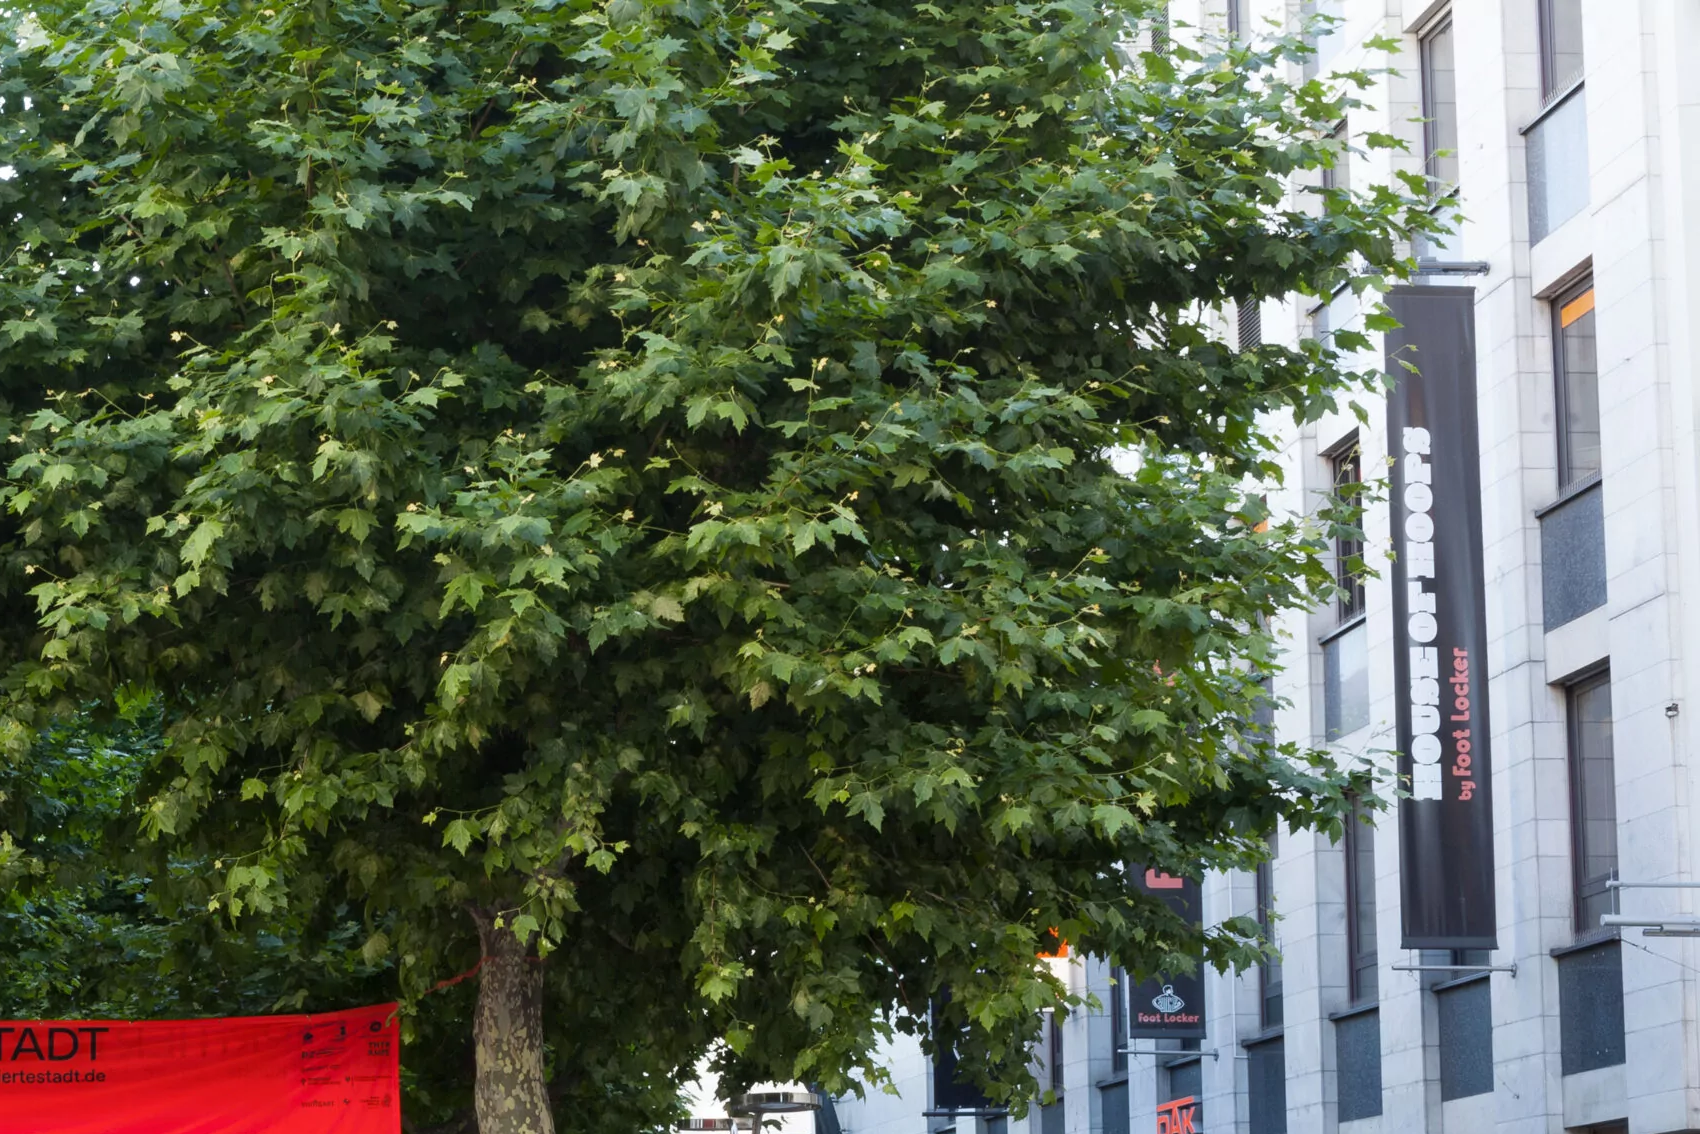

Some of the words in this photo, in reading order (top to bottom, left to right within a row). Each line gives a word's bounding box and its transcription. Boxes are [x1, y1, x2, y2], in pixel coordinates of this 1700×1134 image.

[1402, 427, 1435, 578] HOOPS
[1407, 581, 1438, 643] OF
[1449, 648, 1470, 721] Locker
[1409, 646, 1443, 801] HOUSE
[1452, 729, 1471, 776] Foot
[1458, 780, 1476, 801] by
[1138, 1012, 1161, 1023] Foot
[1164, 1012, 1199, 1023] Locker
